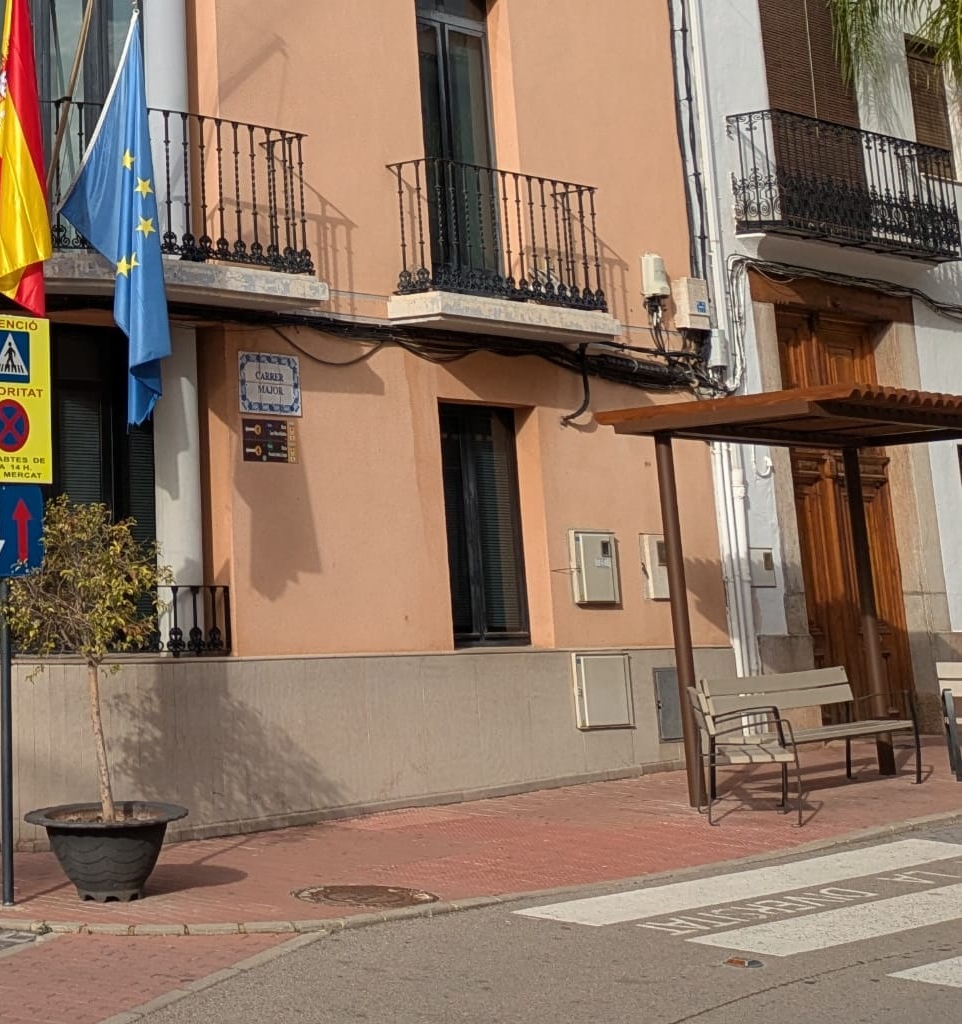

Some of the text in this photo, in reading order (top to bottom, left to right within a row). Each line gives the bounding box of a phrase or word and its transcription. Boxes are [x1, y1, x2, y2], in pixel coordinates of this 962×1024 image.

[255, 371, 284, 382] CARRER
[258, 385, 284, 395] MAJOR
[3, 471, 42, 479] MERCAT
[638, 887, 879, 936] DIVERSITAT
